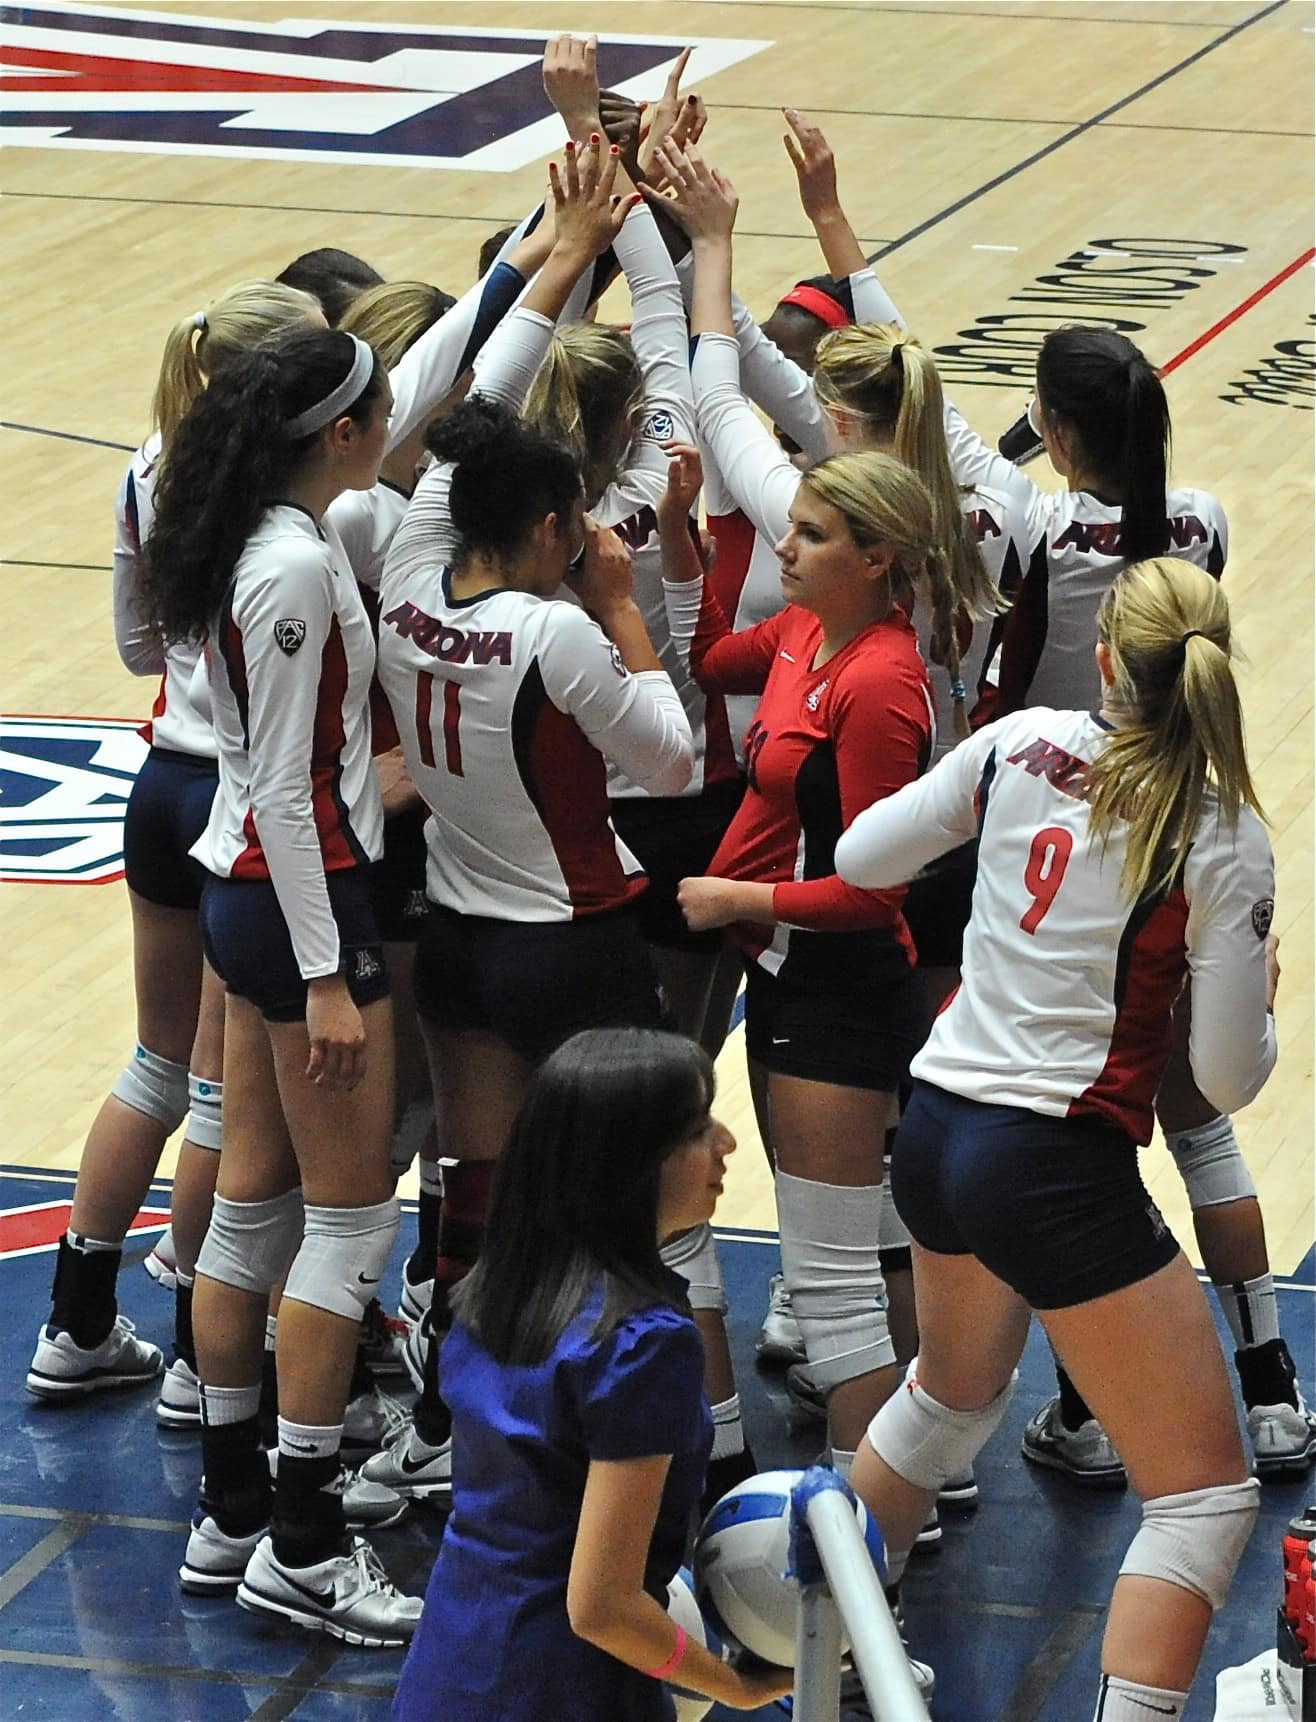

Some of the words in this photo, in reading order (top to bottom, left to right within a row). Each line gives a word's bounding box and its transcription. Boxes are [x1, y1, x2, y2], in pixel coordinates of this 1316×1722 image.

[1008, 238, 1248, 309] OLSON
[1051, 515, 1208, 557] ARIZNA
[276, 620, 304, 641] PAC
[282, 635, 297, 649] 12
[383, 600, 513, 665] ARIZONA
[416, 669, 465, 777] 11
[1020, 827, 1074, 936] 9
